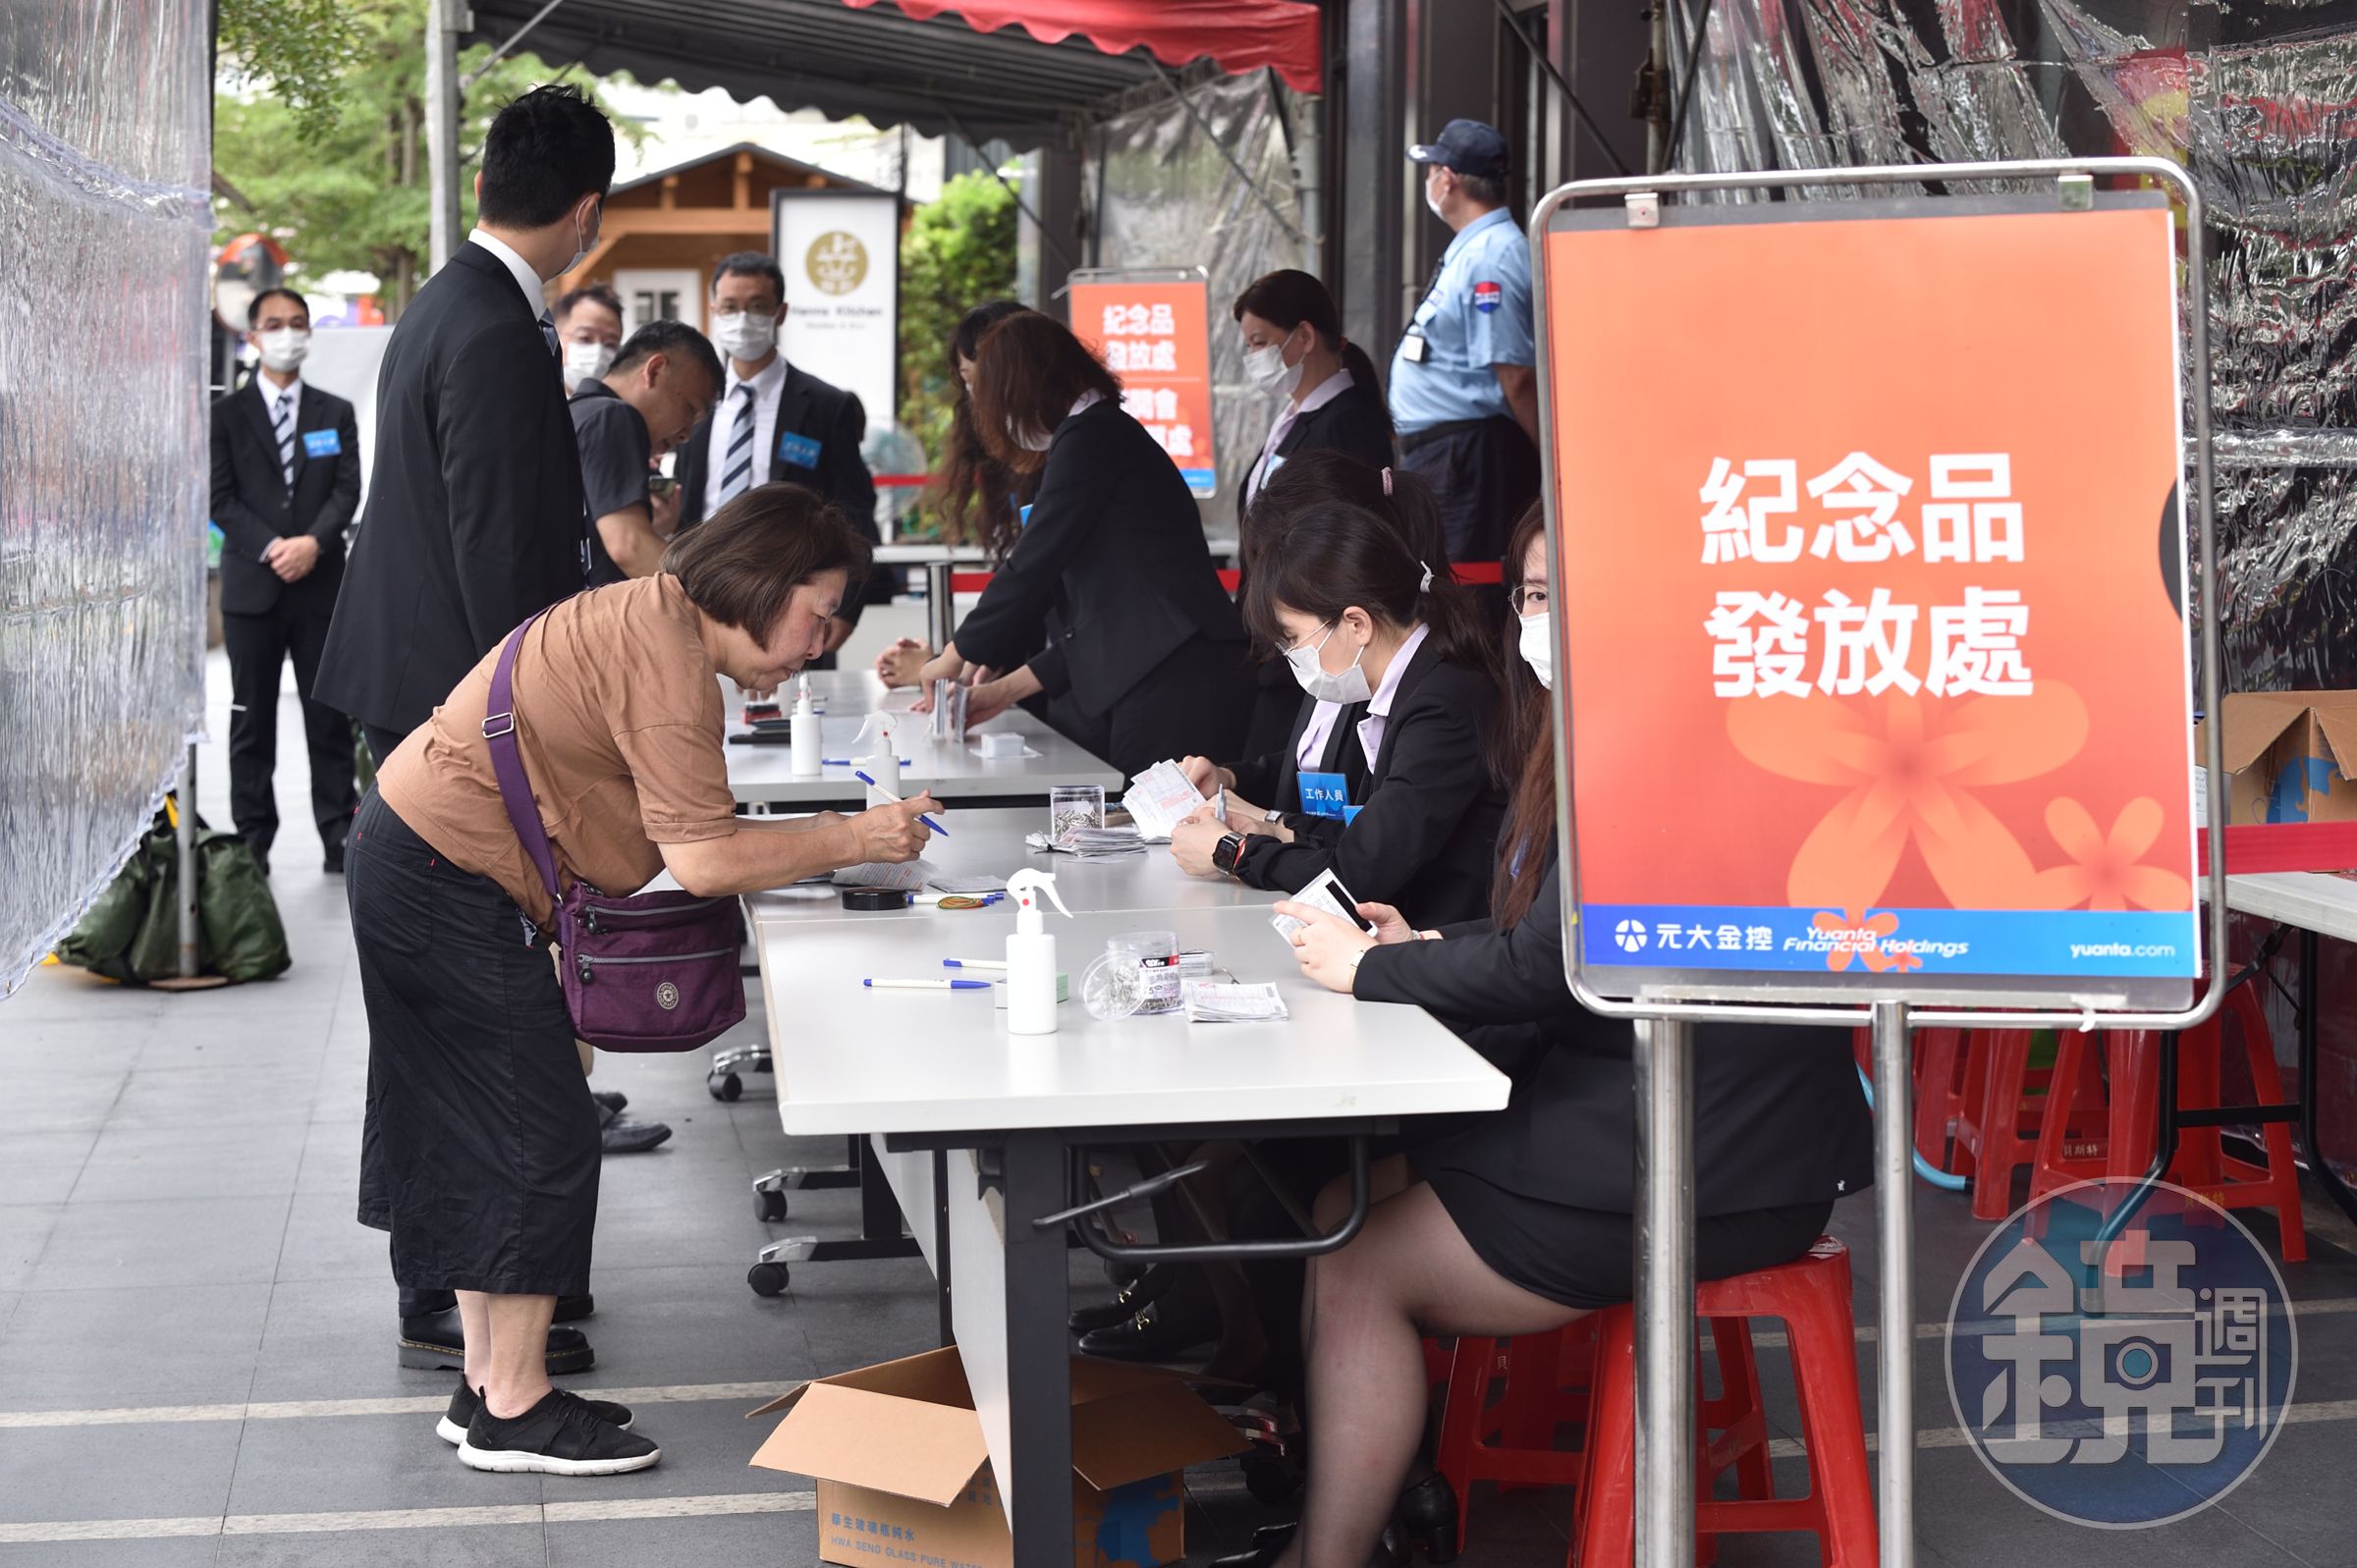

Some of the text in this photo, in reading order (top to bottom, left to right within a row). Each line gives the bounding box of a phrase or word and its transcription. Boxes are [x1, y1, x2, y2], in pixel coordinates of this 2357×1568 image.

[1102, 303, 1176, 336] 紀念品
[1699, 452, 2024, 564] 紀念品
[1703, 586, 2034, 698] 發放處
[1304, 787, 1344, 802] 工作人員
[1656, 924, 1774, 950] 元大金控
[1806, 926, 1878, 941] Yuanta
[1782, 938, 1970, 958] Financial Holdings
[2069, 942, 2176, 959] yuanta.com
[832, 1536, 851, 1548] HWA
[855, 1541, 881, 1554] SENG
[885, 1546, 916, 1562] GLASS
[920, 1554, 946, 1568] PURE
